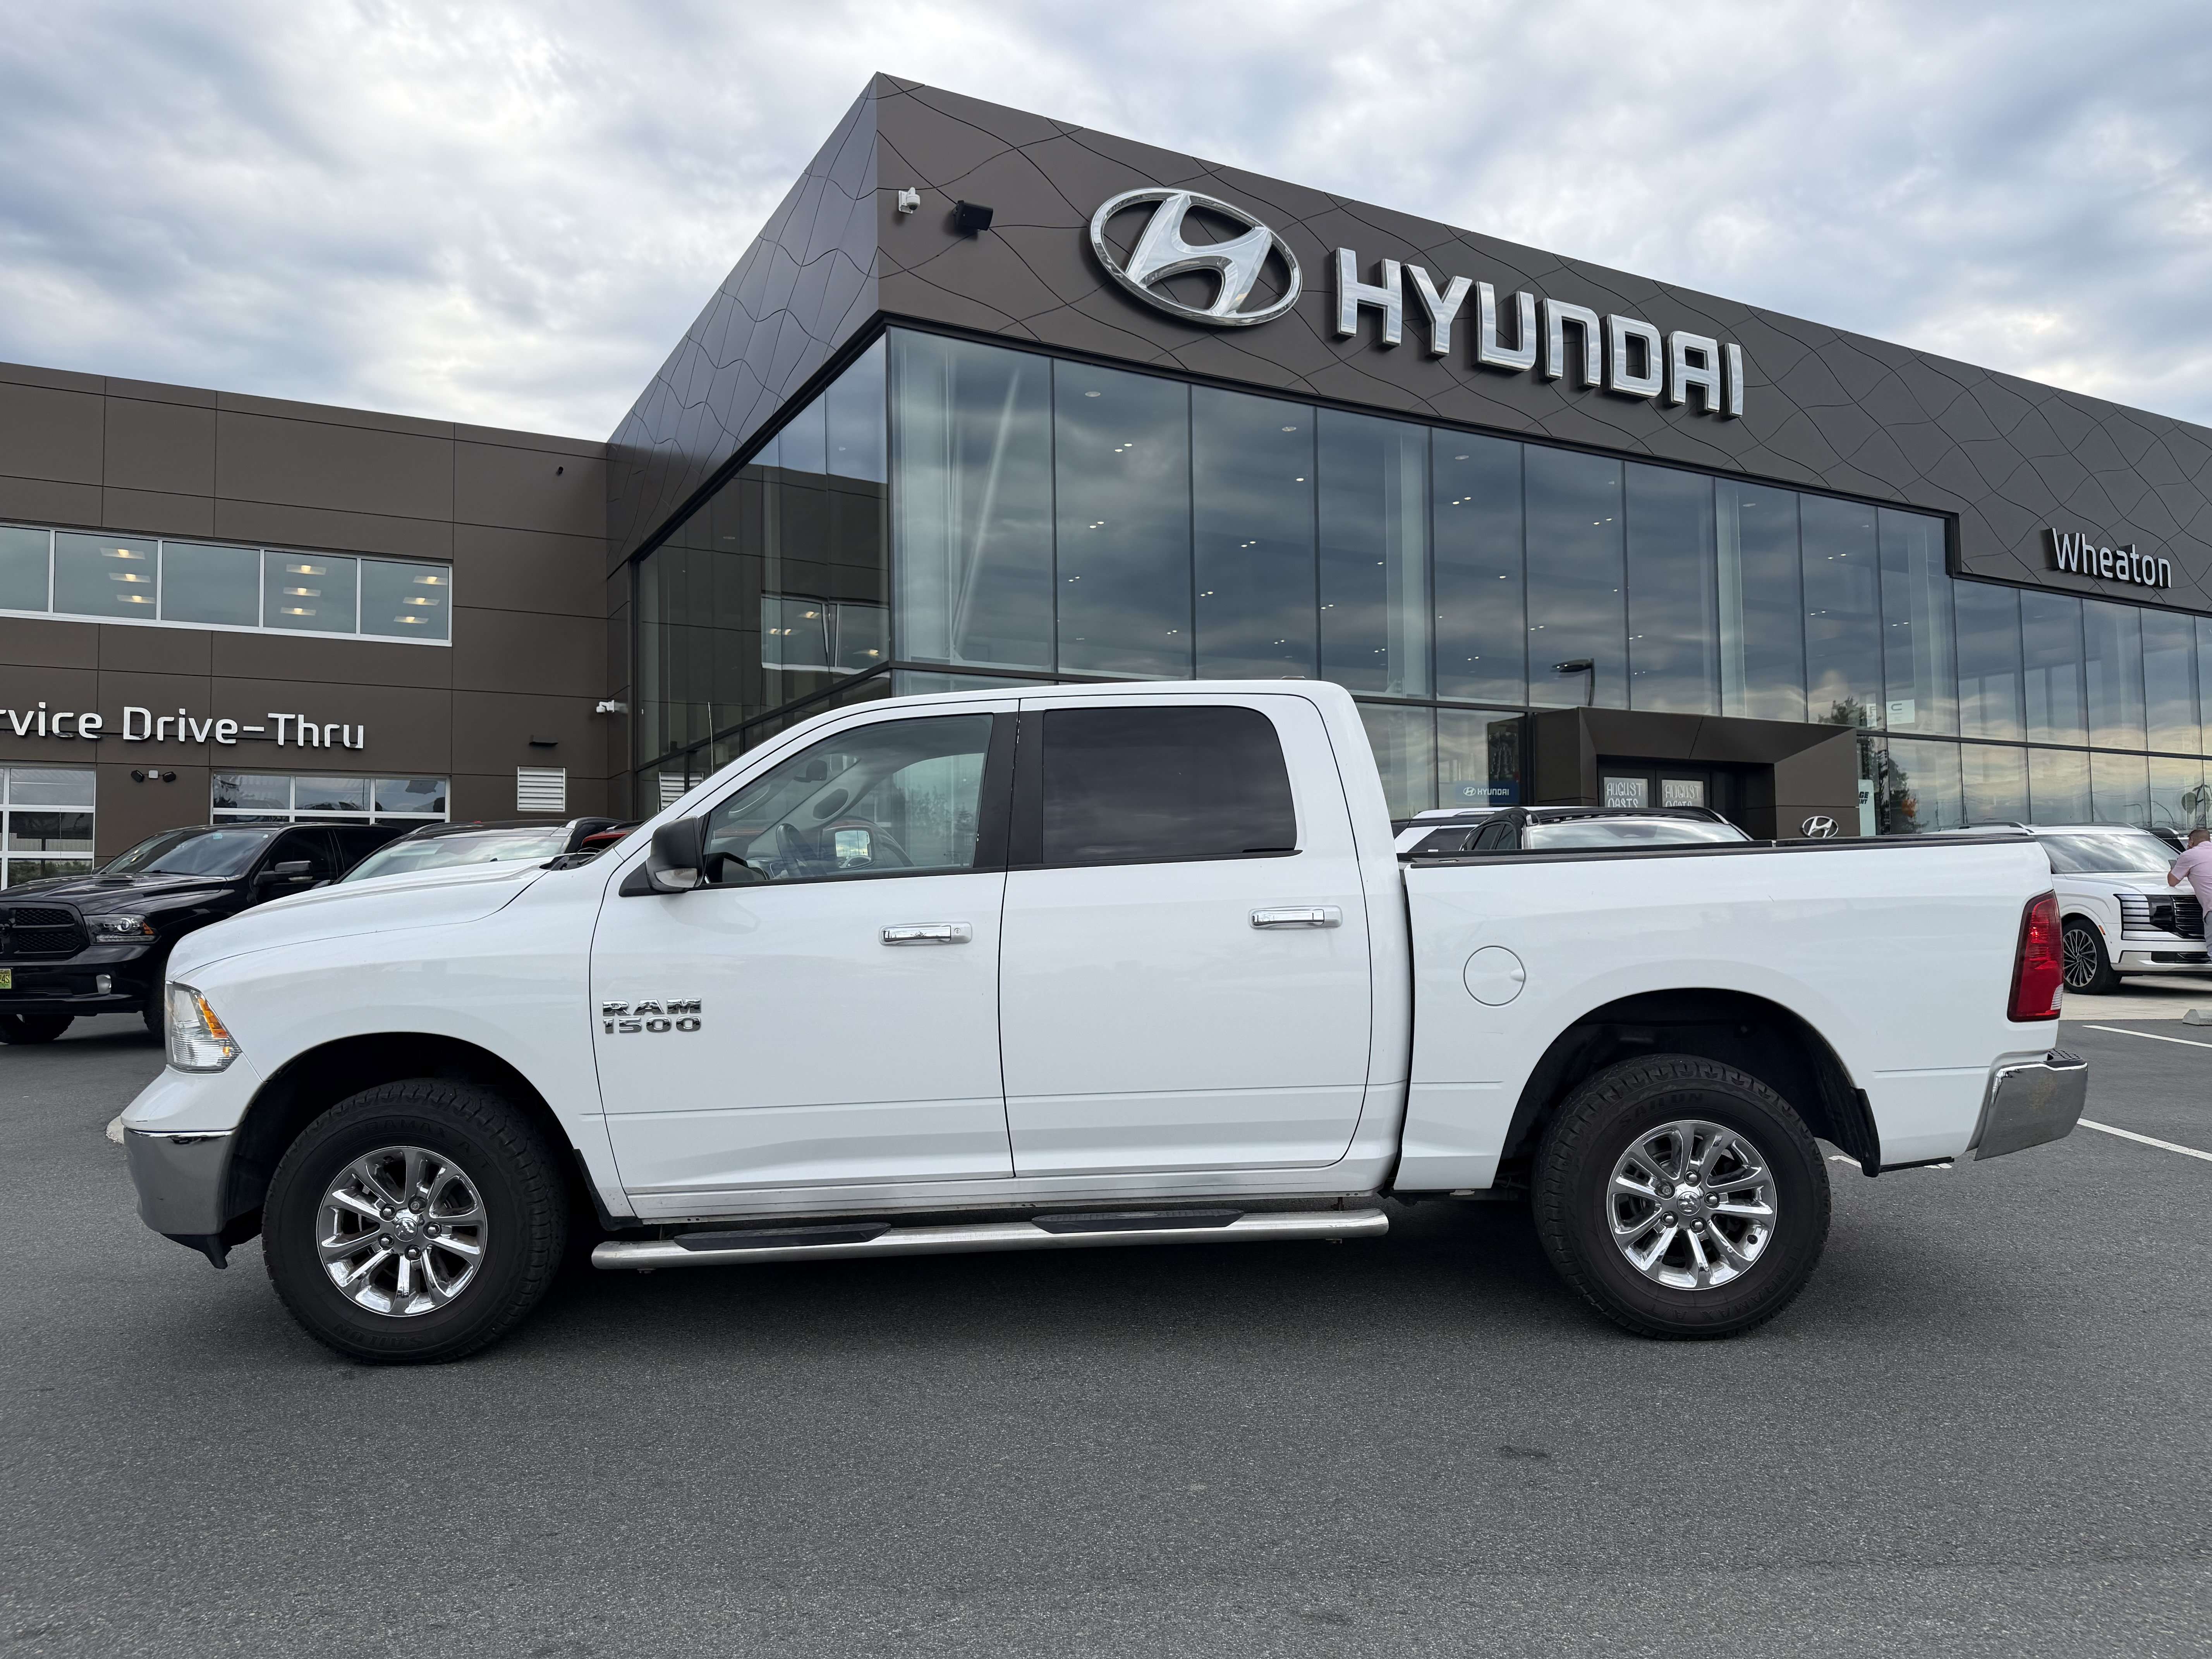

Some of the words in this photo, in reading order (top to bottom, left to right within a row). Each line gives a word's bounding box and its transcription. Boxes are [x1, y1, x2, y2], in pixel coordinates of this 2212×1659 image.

[1336, 247, 1743, 418] HYUNDAI
[2052, 527, 2171, 589] Wheaton
[123, 706, 364, 749] Drive-Thru
[1607, 782, 1642, 796] AUGUST
[1666, 785, 1700, 799] AUGUST
[603, 998, 701, 1016] RAM
[603, 1016, 701, 1034] 1500
[1620, 1093, 1703, 1128] SAILUN
[333, 1322, 425, 1348] SAILUN
